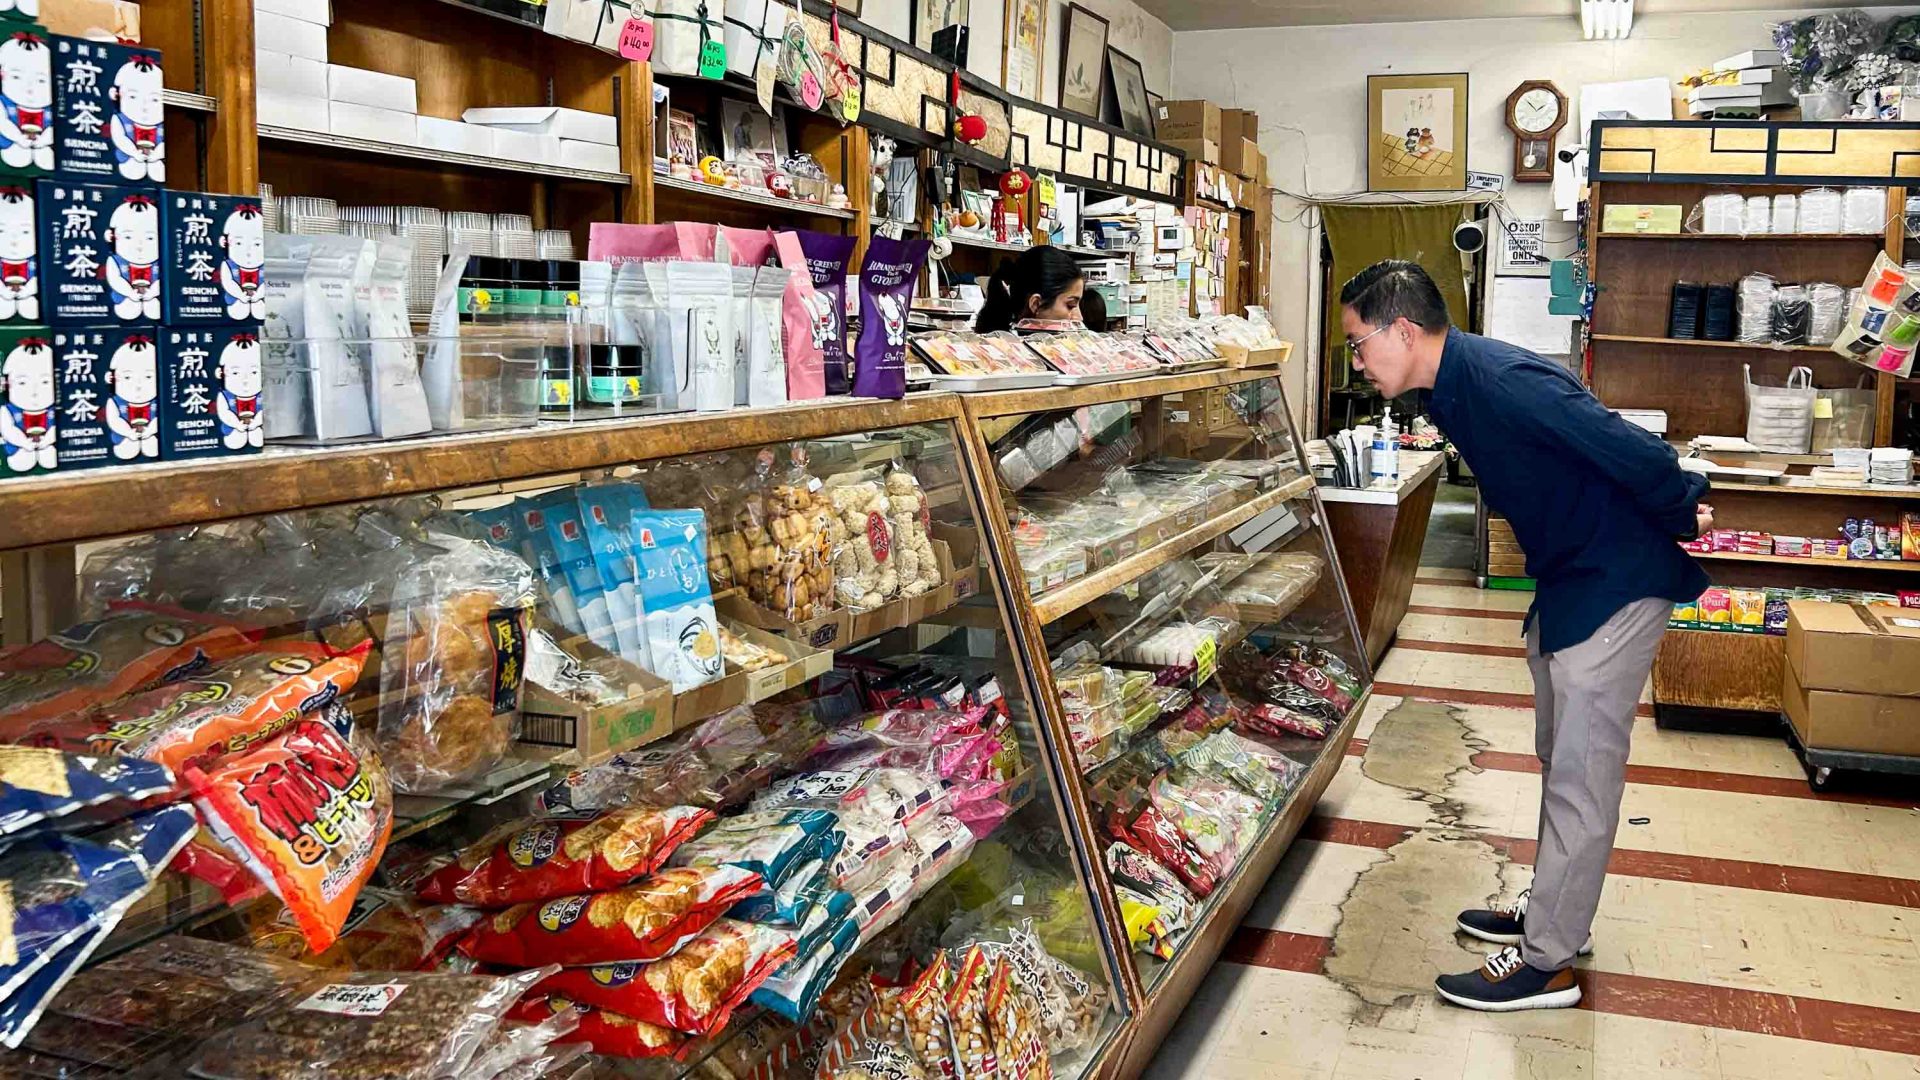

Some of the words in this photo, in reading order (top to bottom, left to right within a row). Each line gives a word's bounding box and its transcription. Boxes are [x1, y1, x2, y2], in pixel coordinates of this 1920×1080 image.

[66, 58, 105, 135] 煎茶
[64, 138, 109, 151] SENCHA
[1476, 175, 1500, 183] EMPLOYEES
[1519, 223, 1541, 233] STOP
[61, 204, 100, 279] 煎茶
[182, 213, 214, 282] 煎茶
[1512, 251, 1534, 260] ONLY
[59, 283, 105, 294] SENCHA
[267, 281, 291, 289] Sencha
[181, 286, 219, 296] SENCHA
[62, 348, 100, 423] 煎茶
[178, 347, 212, 415] 煎茶
[176, 419, 216, 429] SENCHA
[60, 427, 104, 438] SENCHA
